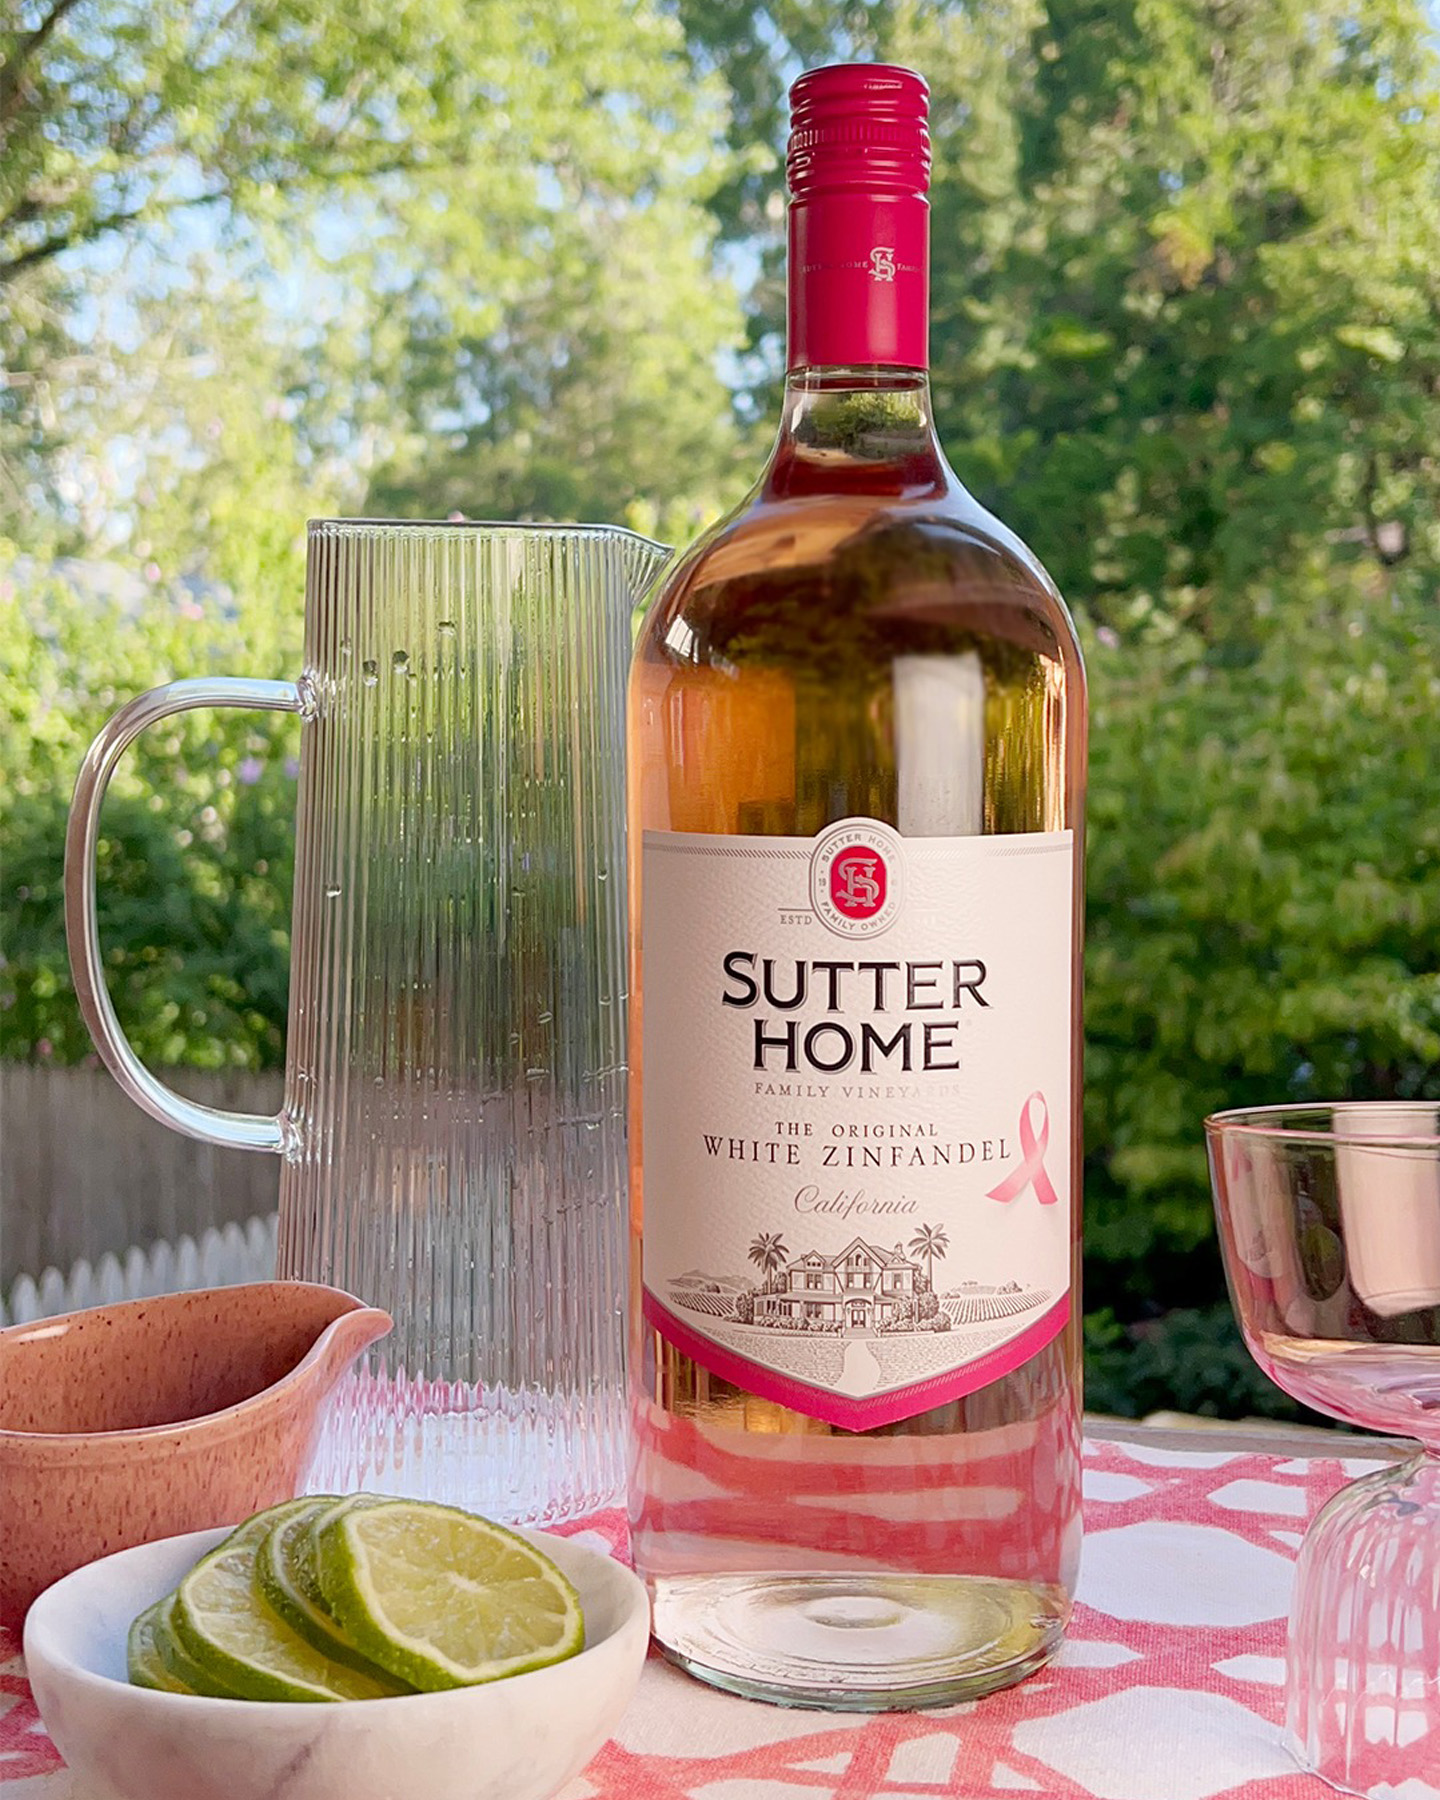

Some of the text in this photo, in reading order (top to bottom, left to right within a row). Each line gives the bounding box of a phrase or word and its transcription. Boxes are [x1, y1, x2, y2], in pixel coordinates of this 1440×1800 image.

[821, 833, 896, 864] SUTTER HOME
[780, 914, 813, 925] ESTD
[820, 901, 856, 931] FAMILY
[860, 902, 896, 931] OWNED
[722, 951, 992, 1012] SUTTER
[753, 1018, 962, 1074] HOME
[754, 1082, 962, 1099] FAMILY VINEYADS
[774, 1121, 938, 1138] THE ORIGINAL
[703, 1134, 1011, 1168] WHITE ZINFANDEL
[793, 1184, 920, 1221] California
